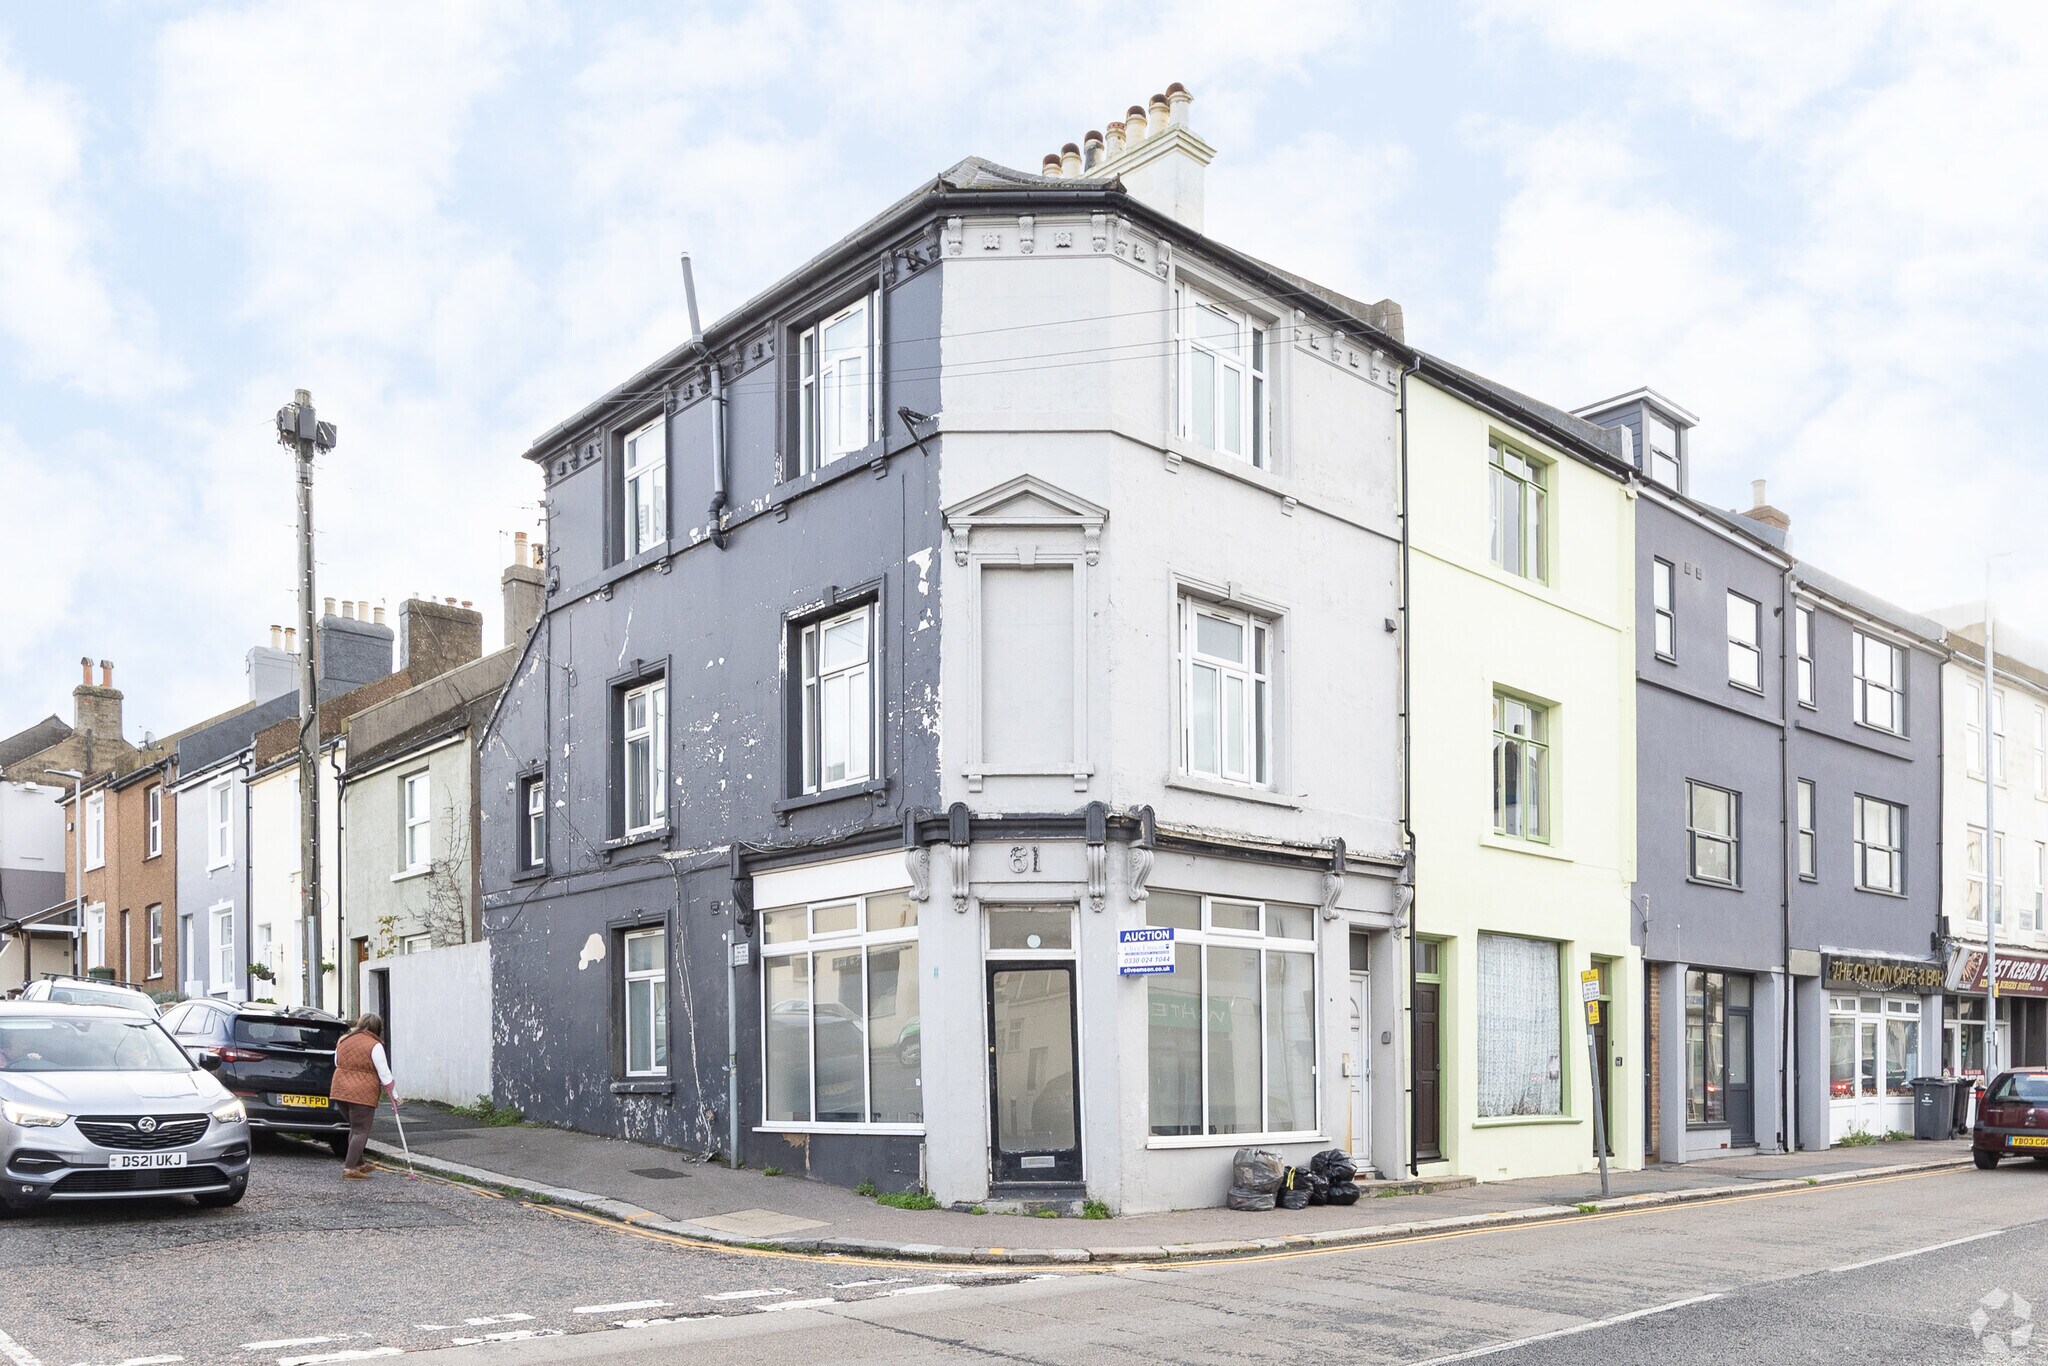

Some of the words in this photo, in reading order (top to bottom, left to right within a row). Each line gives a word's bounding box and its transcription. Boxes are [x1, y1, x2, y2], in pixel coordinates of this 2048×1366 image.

[1009, 845, 1041, 873] 61
[1123, 930, 1170, 942] AUCTION
[1832, 961, 1853, 981] THE
[1854, 963, 1893, 984] CEYLON
[1918, 968, 1926, 986] &
[1926, 969, 1944, 987] BAR
[1982, 959, 2011, 978] EST
[2007, 961, 2039, 981] KEBAB
[282, 1095, 307, 1105] GV73
[2014, 1137, 2034, 1146] YB03
[122, 1155, 152, 1168] DS21
[156, 1154, 182, 1166] UKJ
